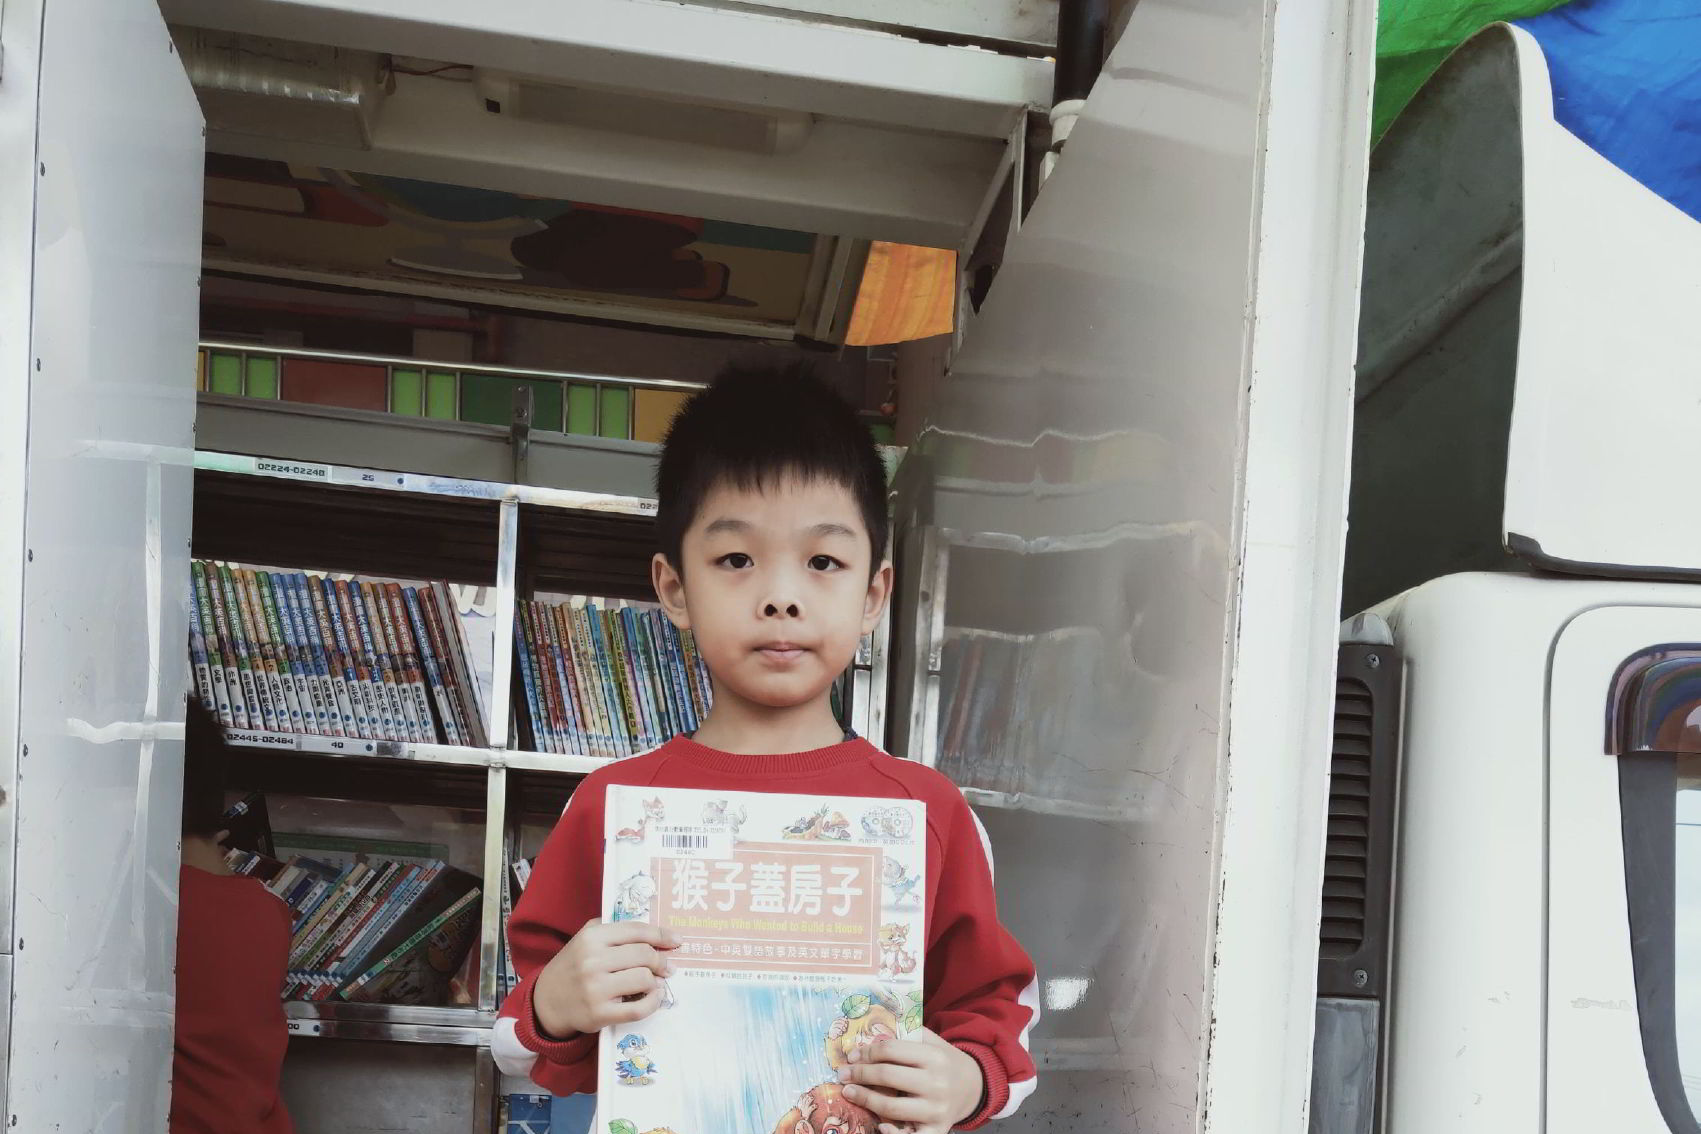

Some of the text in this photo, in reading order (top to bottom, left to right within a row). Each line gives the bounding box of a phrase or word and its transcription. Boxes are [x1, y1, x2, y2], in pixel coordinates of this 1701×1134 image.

[672, 859, 863, 918] 猴子蓋房子
[670, 915, 688, 927] The
[688, 916, 729, 930] Monkeys
[731, 918, 751, 929] Who
[753, 919, 787, 931] Wanted
[790, 921, 799, 932] to
[801, 921, 825, 933] Build
[835, 923, 864, 935] House
